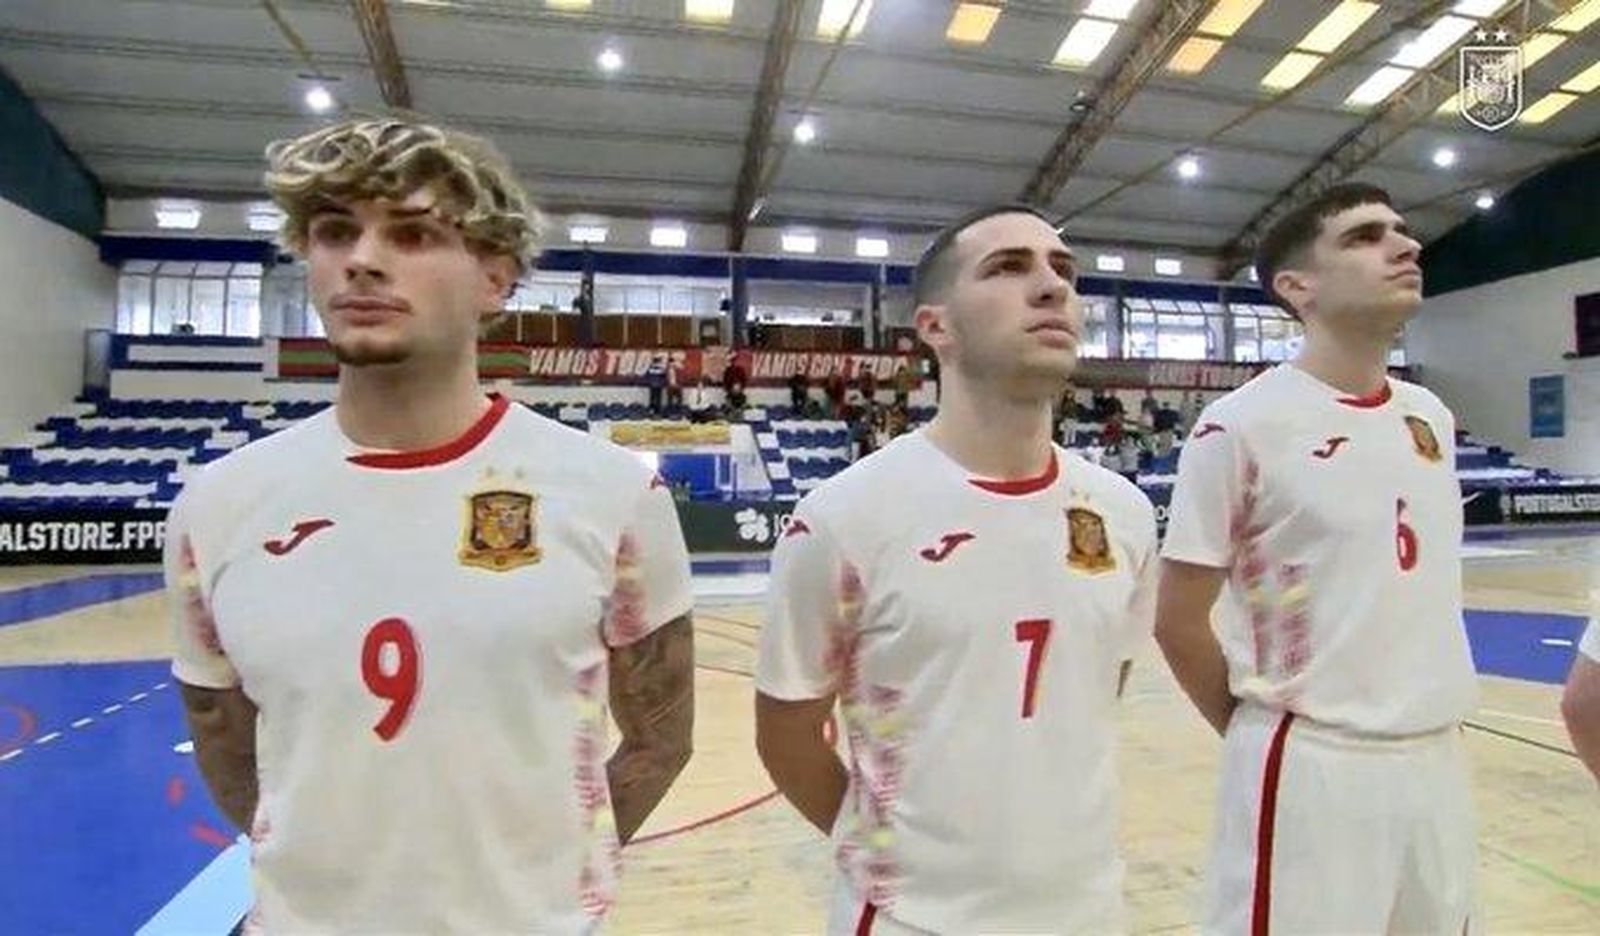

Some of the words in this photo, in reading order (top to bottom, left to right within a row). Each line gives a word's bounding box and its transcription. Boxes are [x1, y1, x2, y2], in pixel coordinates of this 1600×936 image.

[529, 349, 601, 375] VAMOS
[751, 351, 808, 377] VAMOS
[1396, 498, 1418, 571] 6
[361, 617, 423, 741] 9
[1015, 618, 1052, 718] 7
